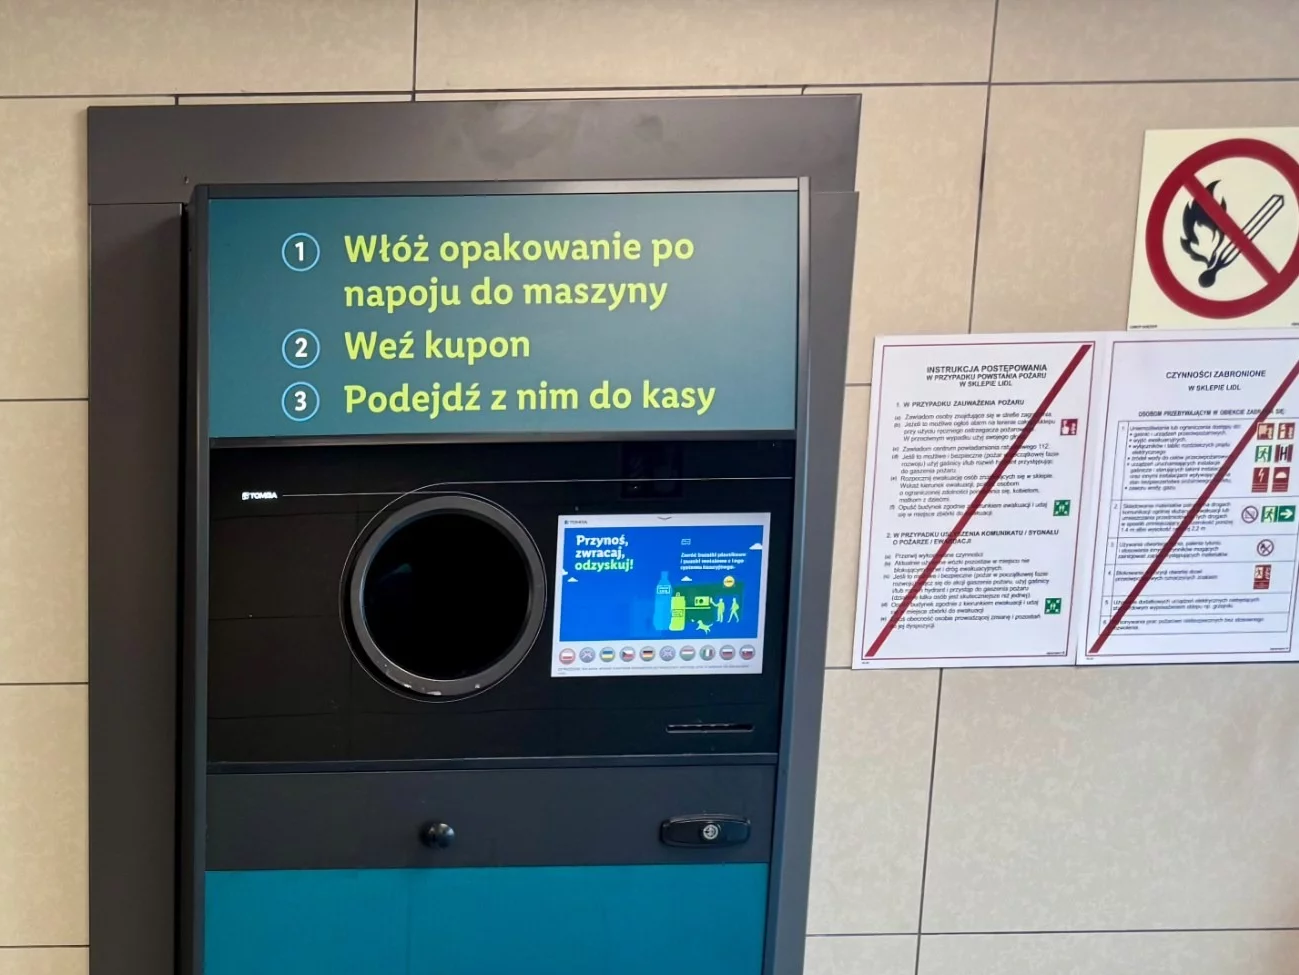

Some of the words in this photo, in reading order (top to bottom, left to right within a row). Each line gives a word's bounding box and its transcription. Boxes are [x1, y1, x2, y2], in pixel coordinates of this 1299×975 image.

[295, 242, 303, 261] 1
[345, 235, 428, 263] Włóż
[440, 232, 643, 269] opakowanie
[652, 237, 694, 268] po
[346, 277, 461, 313] napoju
[470, 277, 514, 306] do
[522, 282, 668, 311] maszyny
[295, 338, 307, 357] 2
[345, 332, 414, 360] Weź
[425, 330, 530, 366] kupon
[981, 364, 1047, 372] POSTĘPOWANIA
[1166, 370, 1212, 378] CZYNNOŚCI
[1214, 370, 1266, 378] ZABRONIONE
[978, 372, 1017, 380] POWSTANIA
[295, 391, 306, 411] 3
[345, 383, 480, 419] Podejdź
[492, 390, 507, 411] z
[517, 382, 579, 410] nim
[589, 380, 633, 410] do
[642, 380, 716, 415] kasy
[576, 535, 628, 548] Przynoś,
[576, 547, 625, 561] zwracaj,
[575, 559, 633, 572] odzyskuj!
